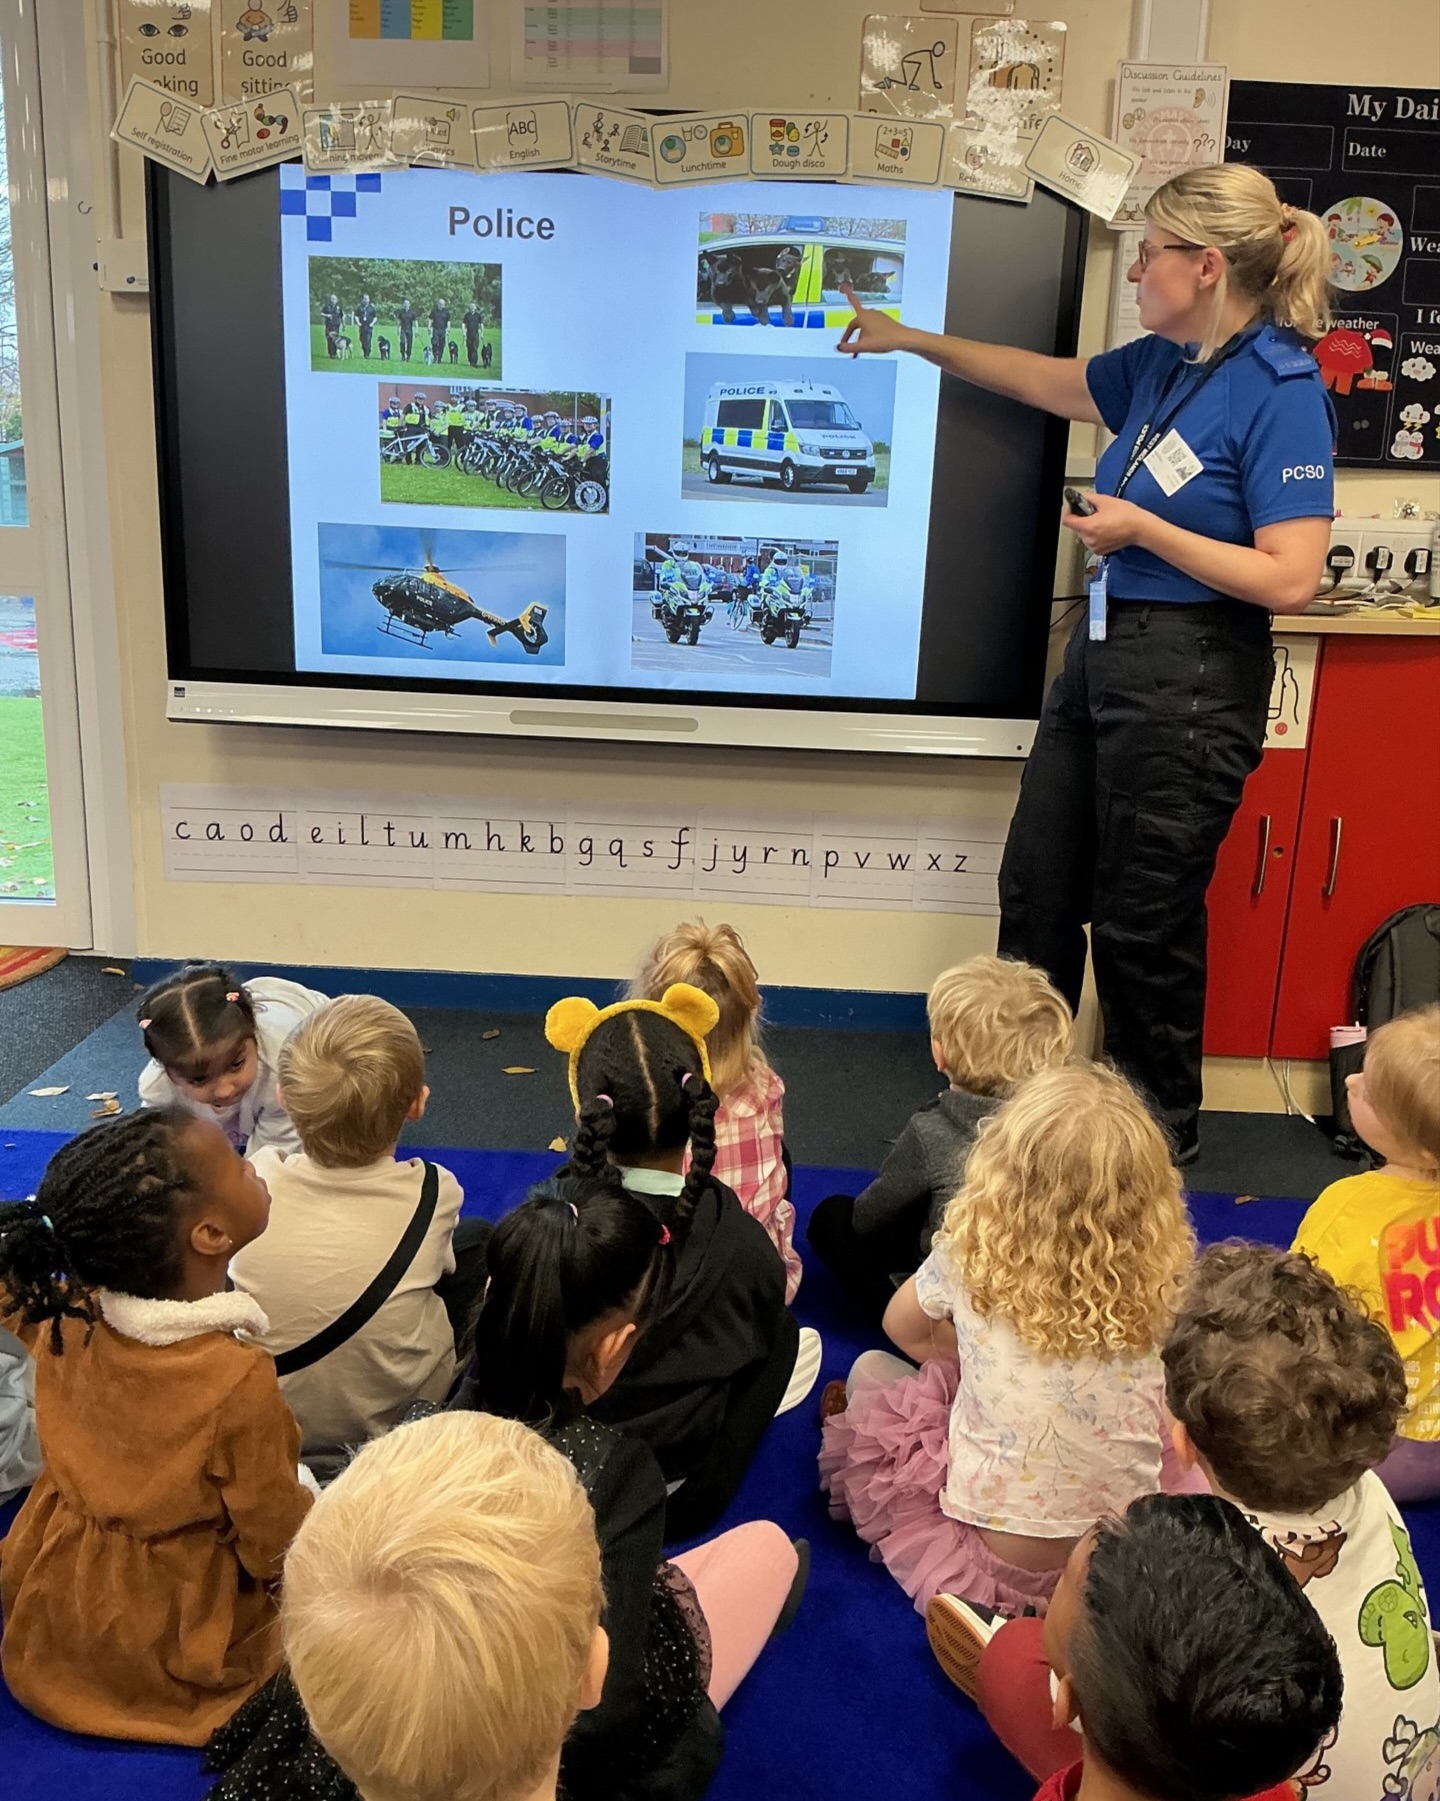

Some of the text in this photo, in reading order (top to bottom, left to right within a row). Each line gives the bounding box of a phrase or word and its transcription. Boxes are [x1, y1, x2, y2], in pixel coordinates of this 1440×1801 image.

[141, 48, 187, 66] Good
[242, 50, 288, 68] Good
[1123, 67, 1222, 81] Discussion Guidelines
[241, 76, 292, 94] sittin
[1346, 93, 1440, 122] My Dai
[509, 120, 536, 135] ABC
[131, 127, 193, 163] Self registration
[219, 134, 300, 164] Fine motor learning
[509, 148, 540, 160] English
[1347, 142, 1387, 158] Date
[595, 152, 637, 170] Storytime
[681, 160, 727, 173] Lunchtime
[772, 158, 825, 170] Dough disco
[876, 162, 904, 174] Maths
[448, 205, 556, 241] Police
[719, 386, 766, 396] POLICE
[1282, 464, 1325, 484] PCSO
